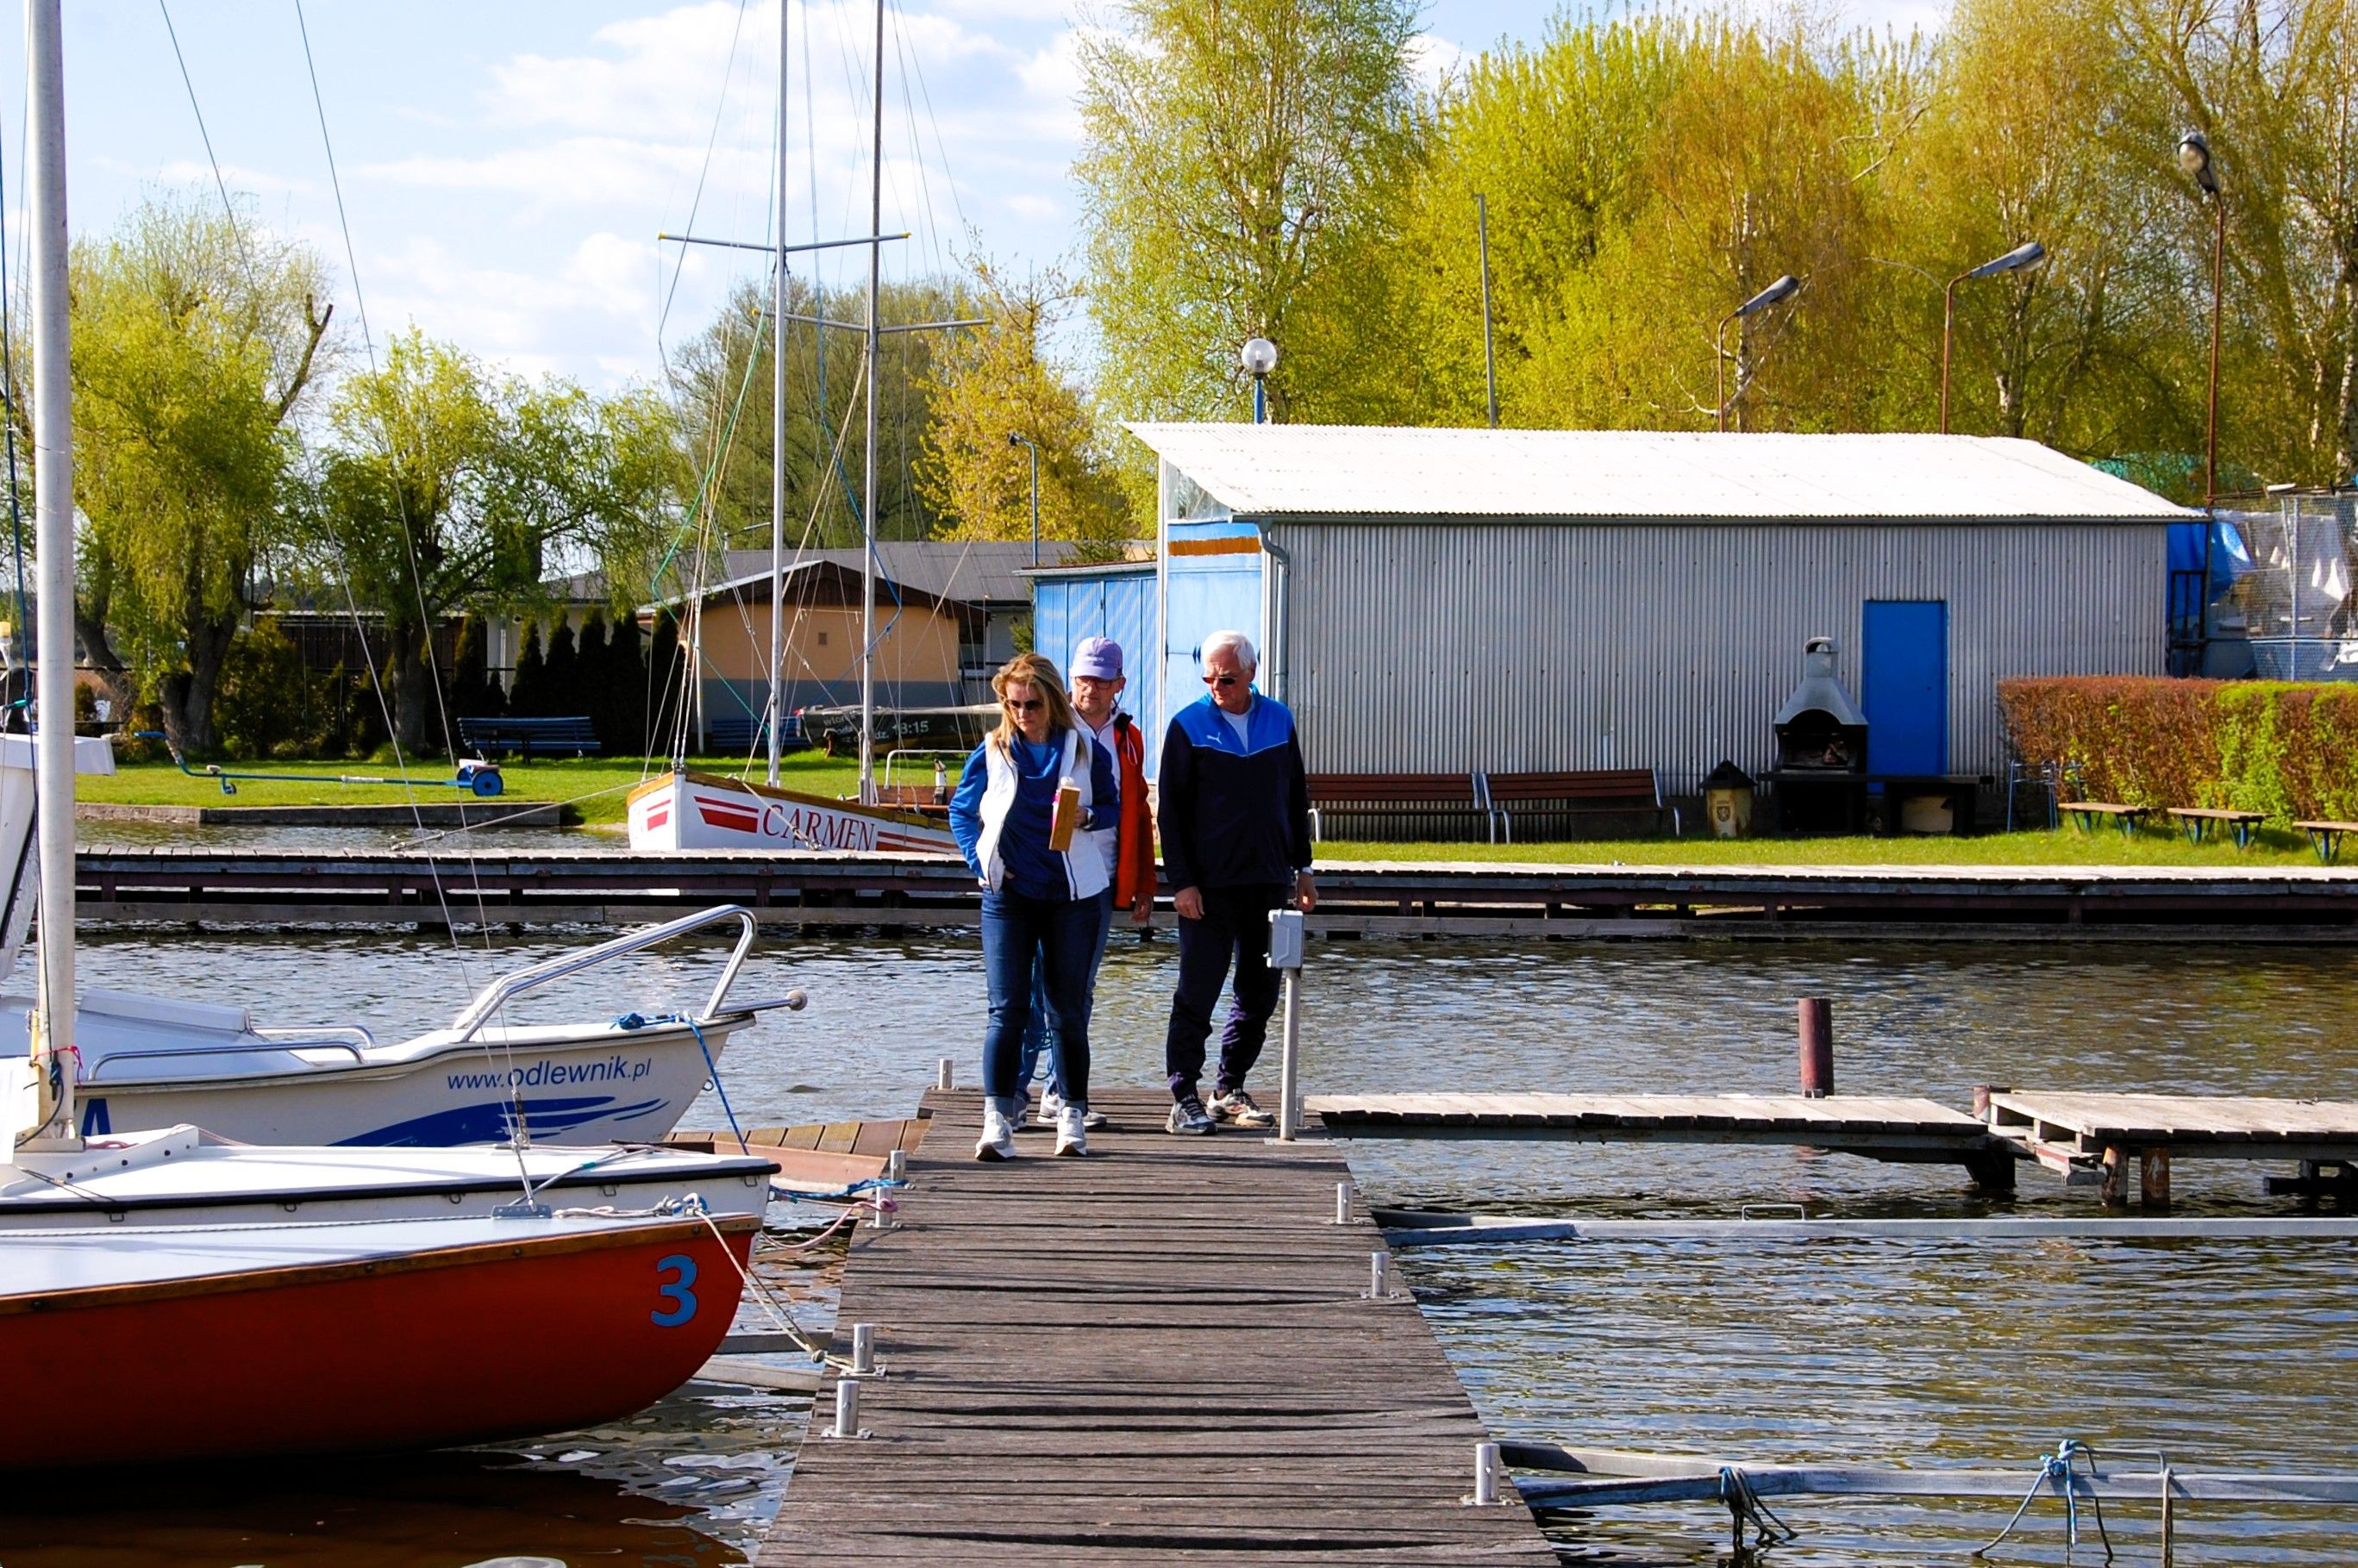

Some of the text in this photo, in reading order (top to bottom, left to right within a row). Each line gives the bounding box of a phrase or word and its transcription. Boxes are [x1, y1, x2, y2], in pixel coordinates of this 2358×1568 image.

[891, 721, 929, 735] 18:15
[763, 804, 875, 851] CARMEN
[447, 1056, 652, 1090] www.odlewnik.pl
[651, 1254, 697, 1327] 3
